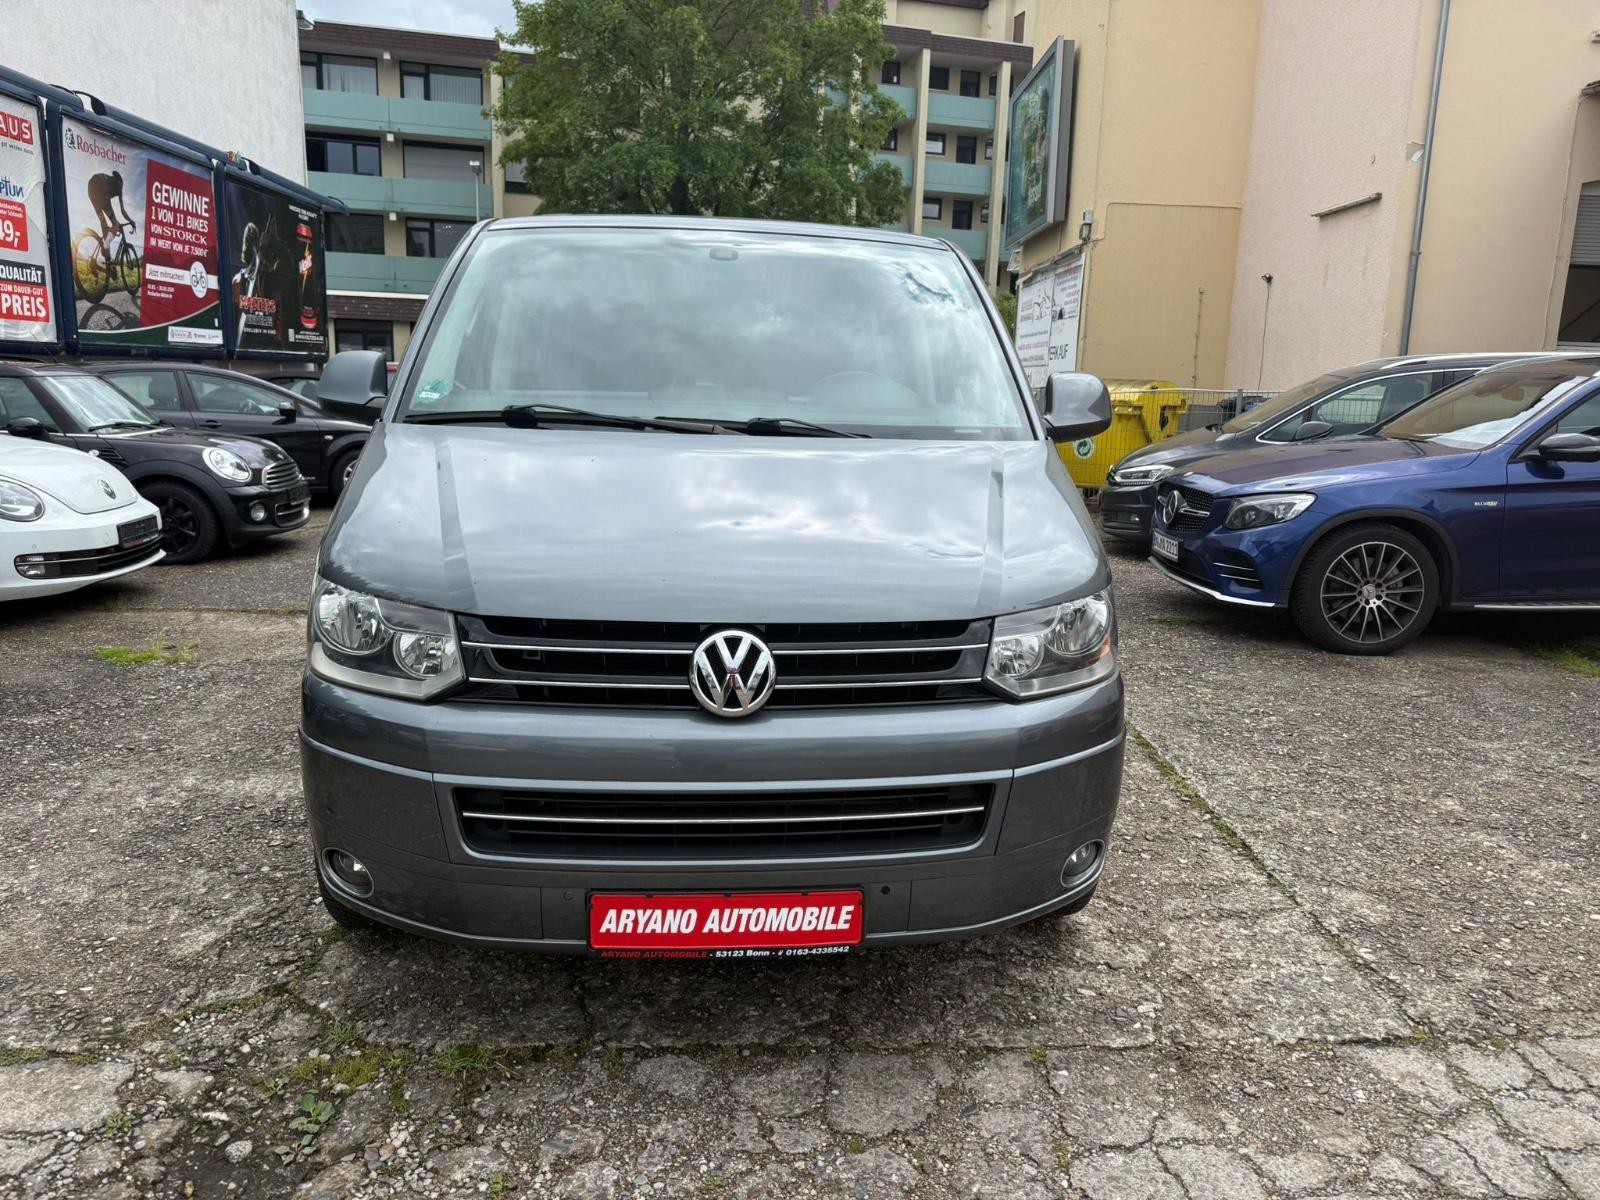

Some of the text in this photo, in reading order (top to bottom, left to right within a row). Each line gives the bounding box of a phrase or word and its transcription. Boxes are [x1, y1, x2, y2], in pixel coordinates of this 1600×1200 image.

[76, 134, 127, 165] Rosbacher
[152, 181, 210, 217] GEWINNE
[151, 206, 209, 233] 1 VON 11 BIKES
[150, 223, 208, 245] VON STORCK
[157, 238, 171, 250] WERT
[172, 242, 183, 252] VON
[184, 244, 190, 254] JE
[0, 265, 42, 283] QUALITÄT
[0, 283, 12, 292] ZUM
[1, 293, 46, 318] PREIS
[599, 905, 855, 934] ARYANO AUTOMOBILE
[601, 950, 641, 959] ARYANO
[643, 950, 708, 959] AUTOMOBILE
[715, 950, 744, 958] 53123
[746, 949, 770, 957] Bonn
